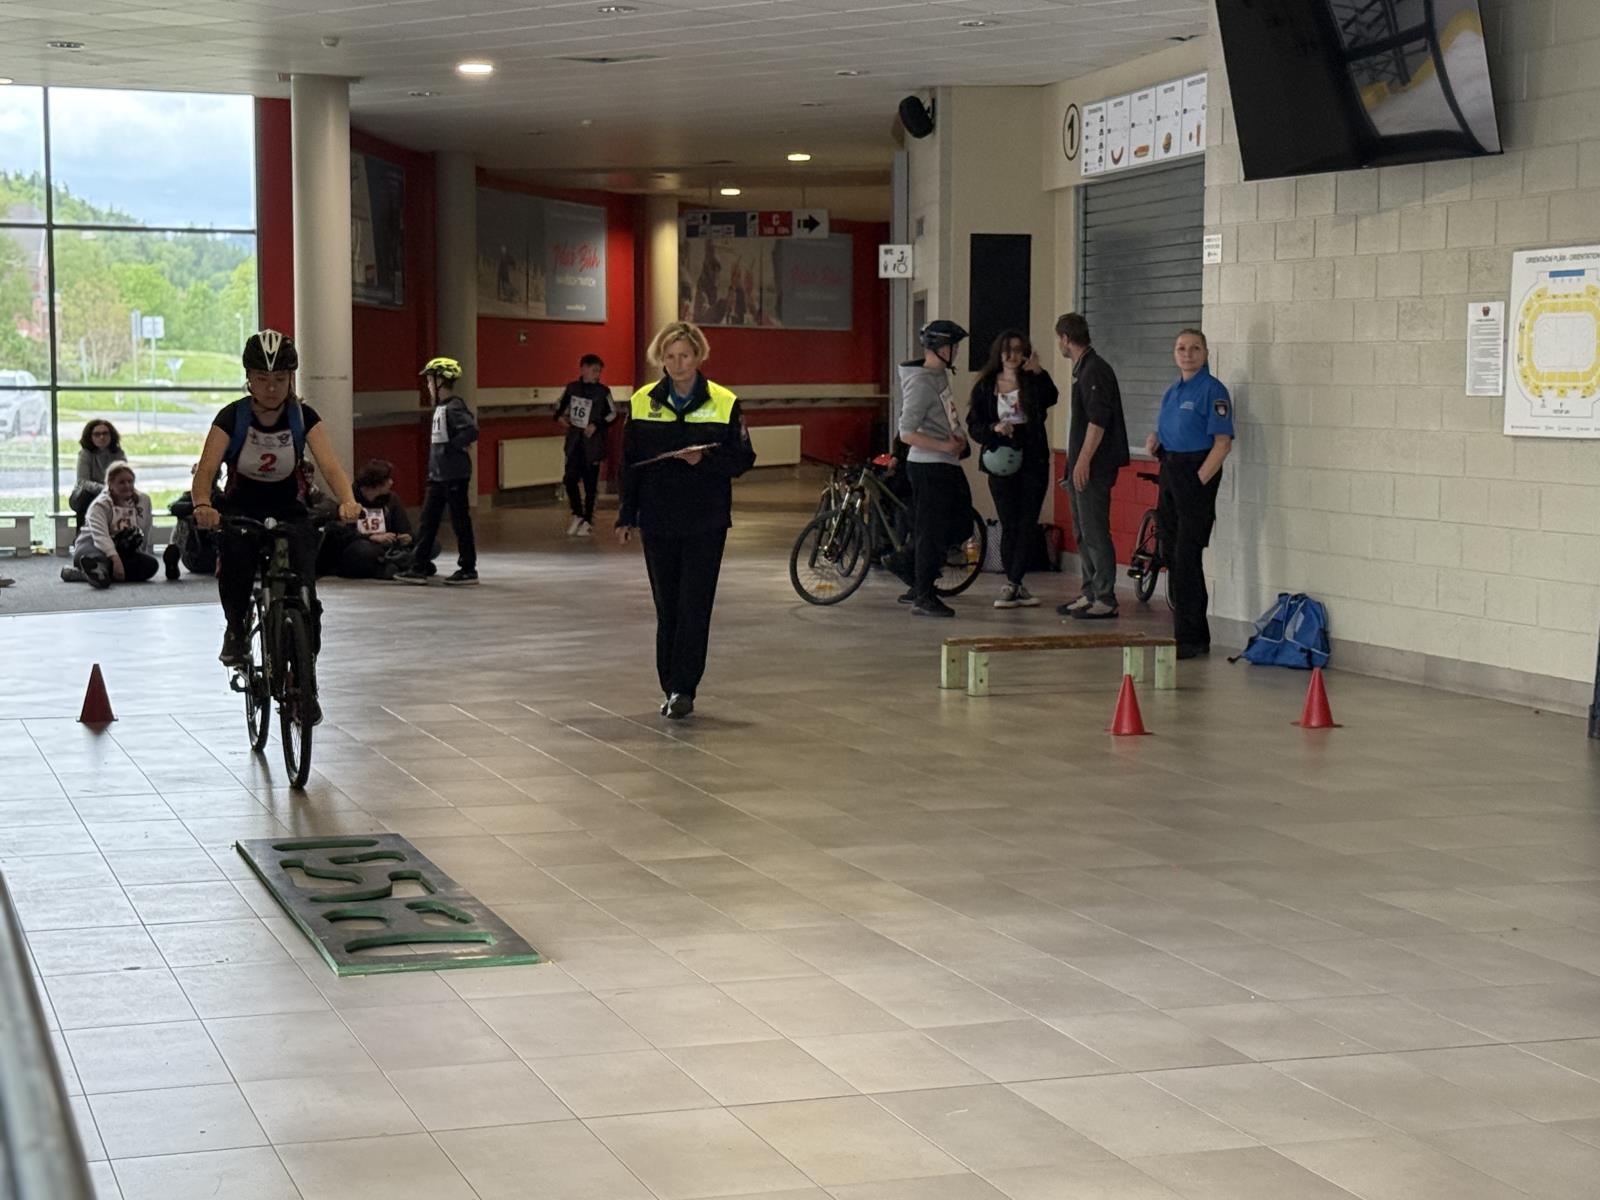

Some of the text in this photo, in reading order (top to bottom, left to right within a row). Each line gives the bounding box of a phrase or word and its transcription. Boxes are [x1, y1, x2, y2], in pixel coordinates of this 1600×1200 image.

[1067, 114, 1075, 150] 1
[772, 213, 780, 226] C
[573, 406, 586, 418] 16
[258, 453, 277, 473] 2
[362, 518, 380, 531] 15
